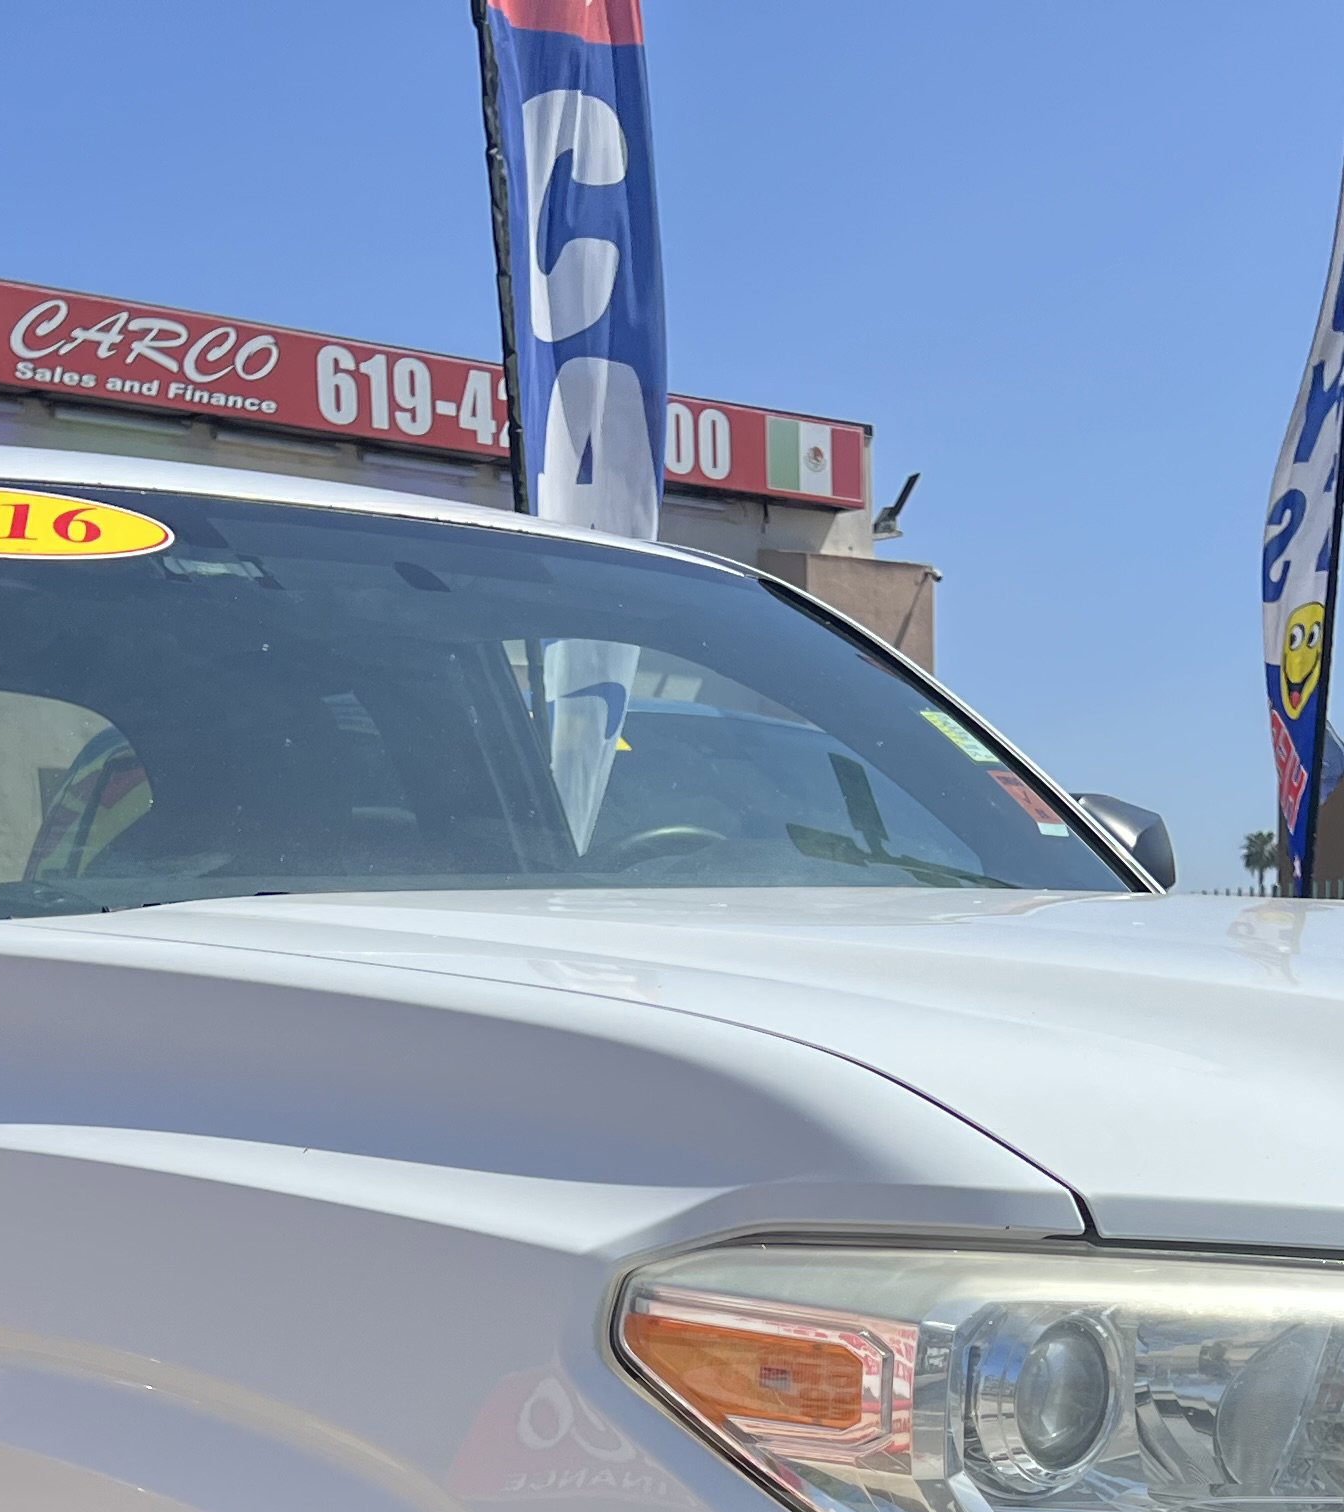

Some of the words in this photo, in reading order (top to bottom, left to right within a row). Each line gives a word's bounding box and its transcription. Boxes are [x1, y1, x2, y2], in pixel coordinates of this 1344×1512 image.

[9, 299, 281, 384] CARCO
[14, 361, 97, 389] Sales
[105, 373, 161, 397] and
[167, 381, 279, 415] Finance
